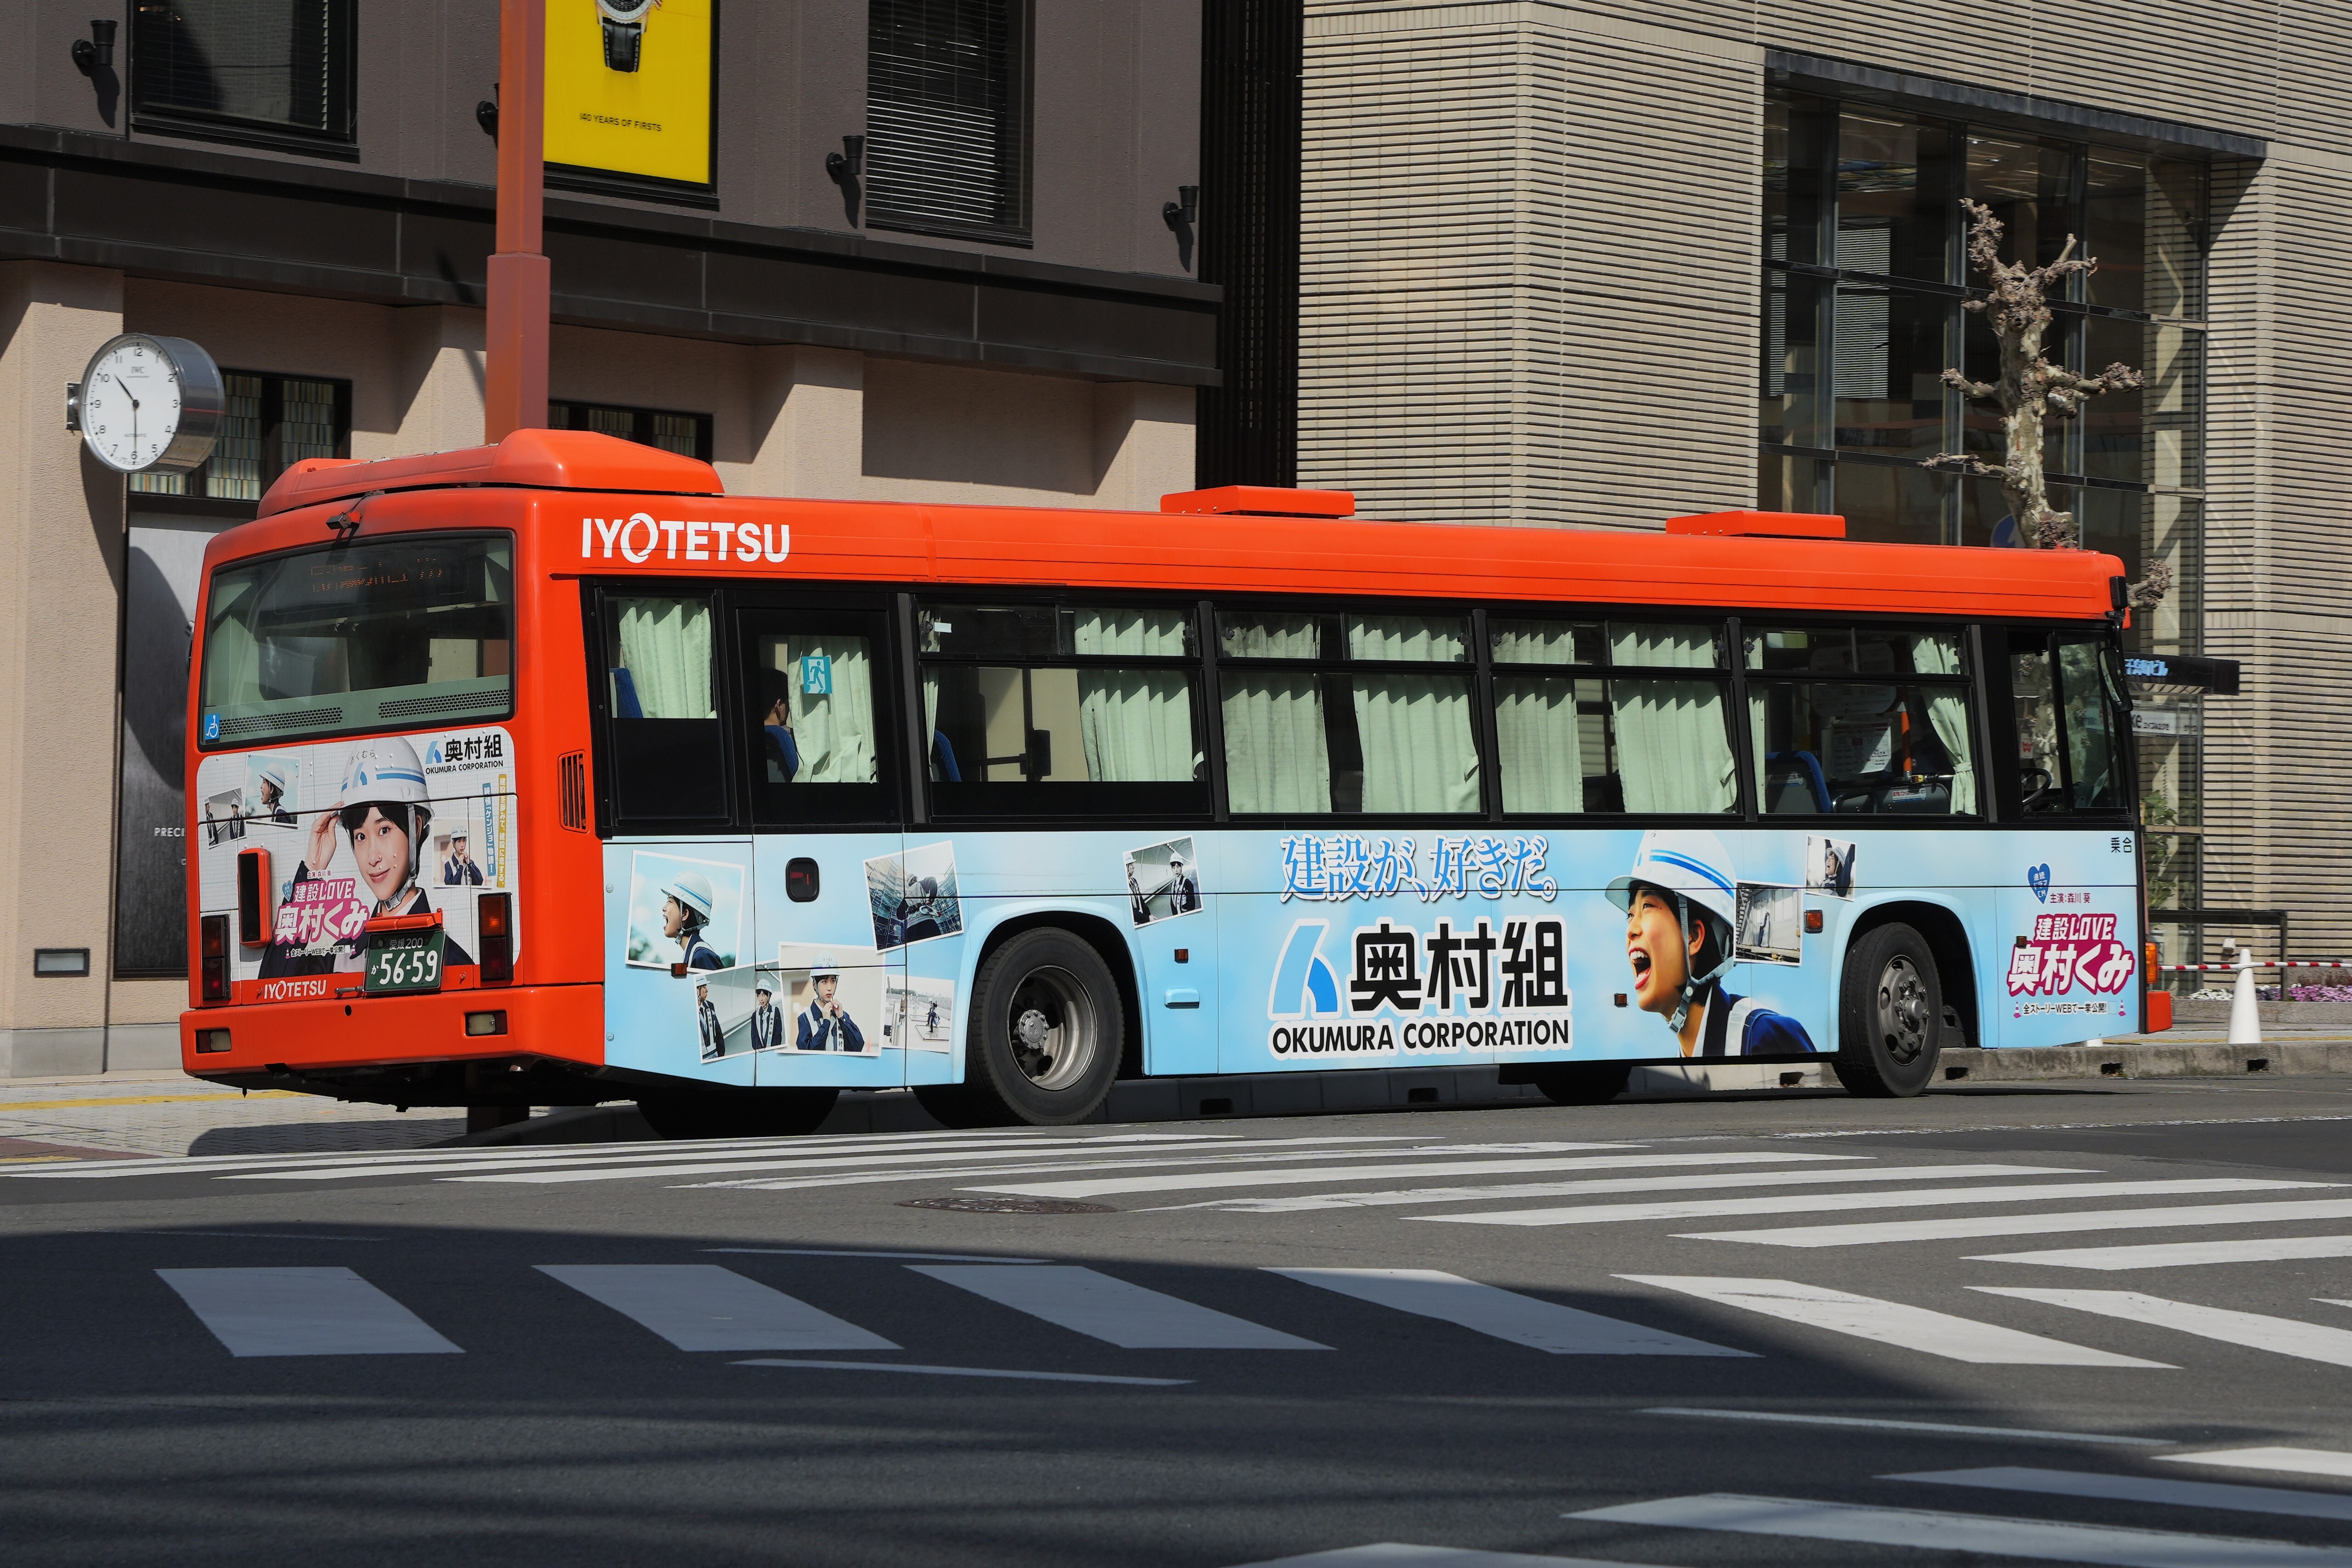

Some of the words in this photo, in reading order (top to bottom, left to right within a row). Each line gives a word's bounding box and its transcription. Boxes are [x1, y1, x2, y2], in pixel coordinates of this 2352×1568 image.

[593, 115, 619, 125] YEARS
[634, 121, 662, 131] FIRSTS
[115, 355, 123, 363] 11
[133, 348, 143, 357] 12
[100, 374, 110, 382] 10
[168, 374, 174, 382] 2
[94, 400, 101, 408] 9
[172, 399, 179, 408] 3
[99, 425, 106, 434] 8
[112, 444, 118, 453] 7
[131, 451, 137, 459] 6
[152, 444, 158, 453] 5
[582, 513, 789, 563] IYOTETSU
[444, 734, 503, 762] 奥村組
[351, 749, 375, 765] おくむら
[425, 764, 456, 775] OKUMURA
[459, 760, 503, 771] CORPORATION
[2111, 837, 2132, 853] 乗合
[1281, 834, 1557, 901] 建設が、好きだ。
[295, 881, 353, 903] 建設LOVE
[2037, 890, 2046, 899] CM
[276, 900, 368, 942] 奥村くみ
[2035, 917, 2114, 941] 建設LOVE
[379, 950, 438, 985] 56-59
[1351, 922, 1568, 1011] 奥村組
[2008, 943, 2133, 992] 奥村くみ
[264, 980, 327, 1000] IYOTETSU
[1272, 1024, 1394, 1054] OKUMURA
[1404, 1019, 1569, 1048] CORPORATION
